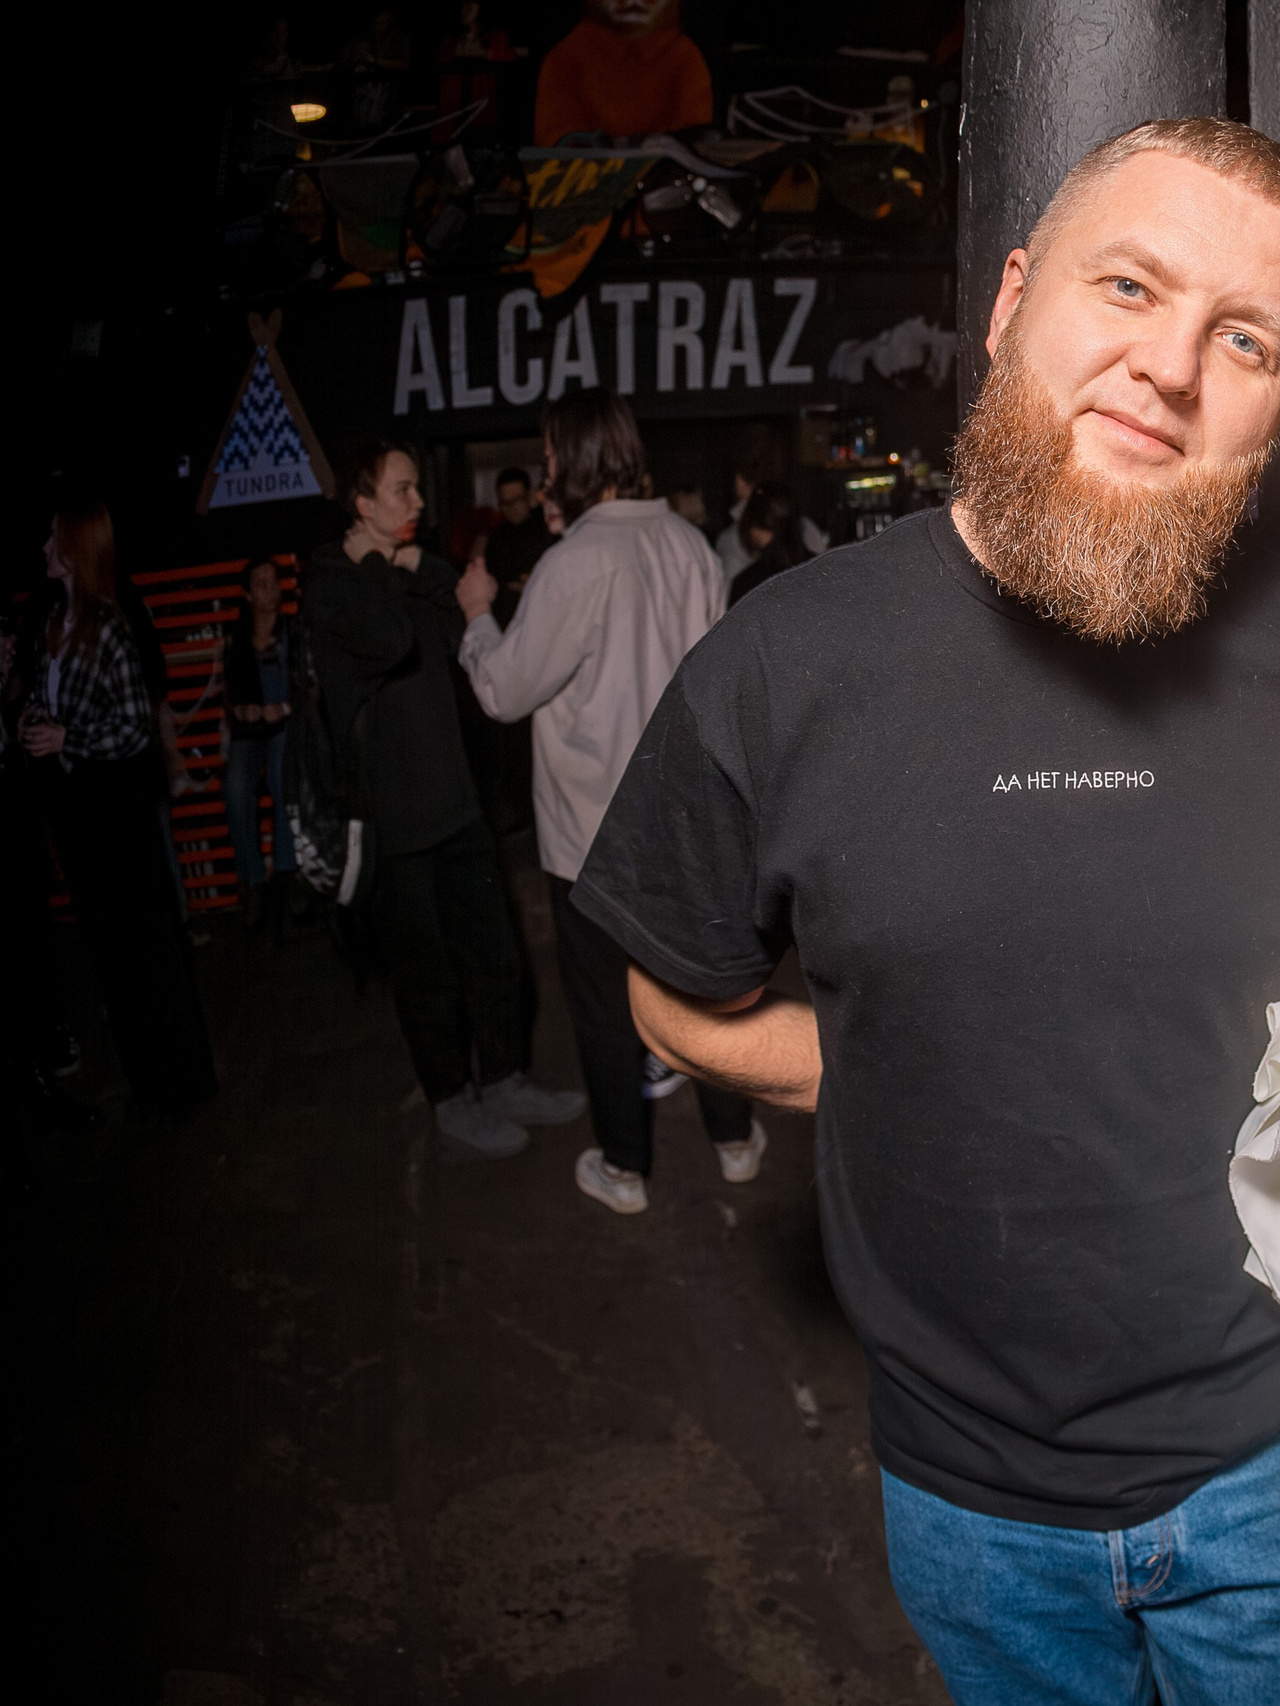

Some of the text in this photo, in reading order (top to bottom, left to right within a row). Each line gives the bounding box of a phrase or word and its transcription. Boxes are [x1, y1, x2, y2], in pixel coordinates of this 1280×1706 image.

[393, 277, 818, 417] ALCATRAZ
[225, 472, 304, 497] TUNDRA
[992, 770, 1155, 794] ДА НЕТ НАВЕРНО
